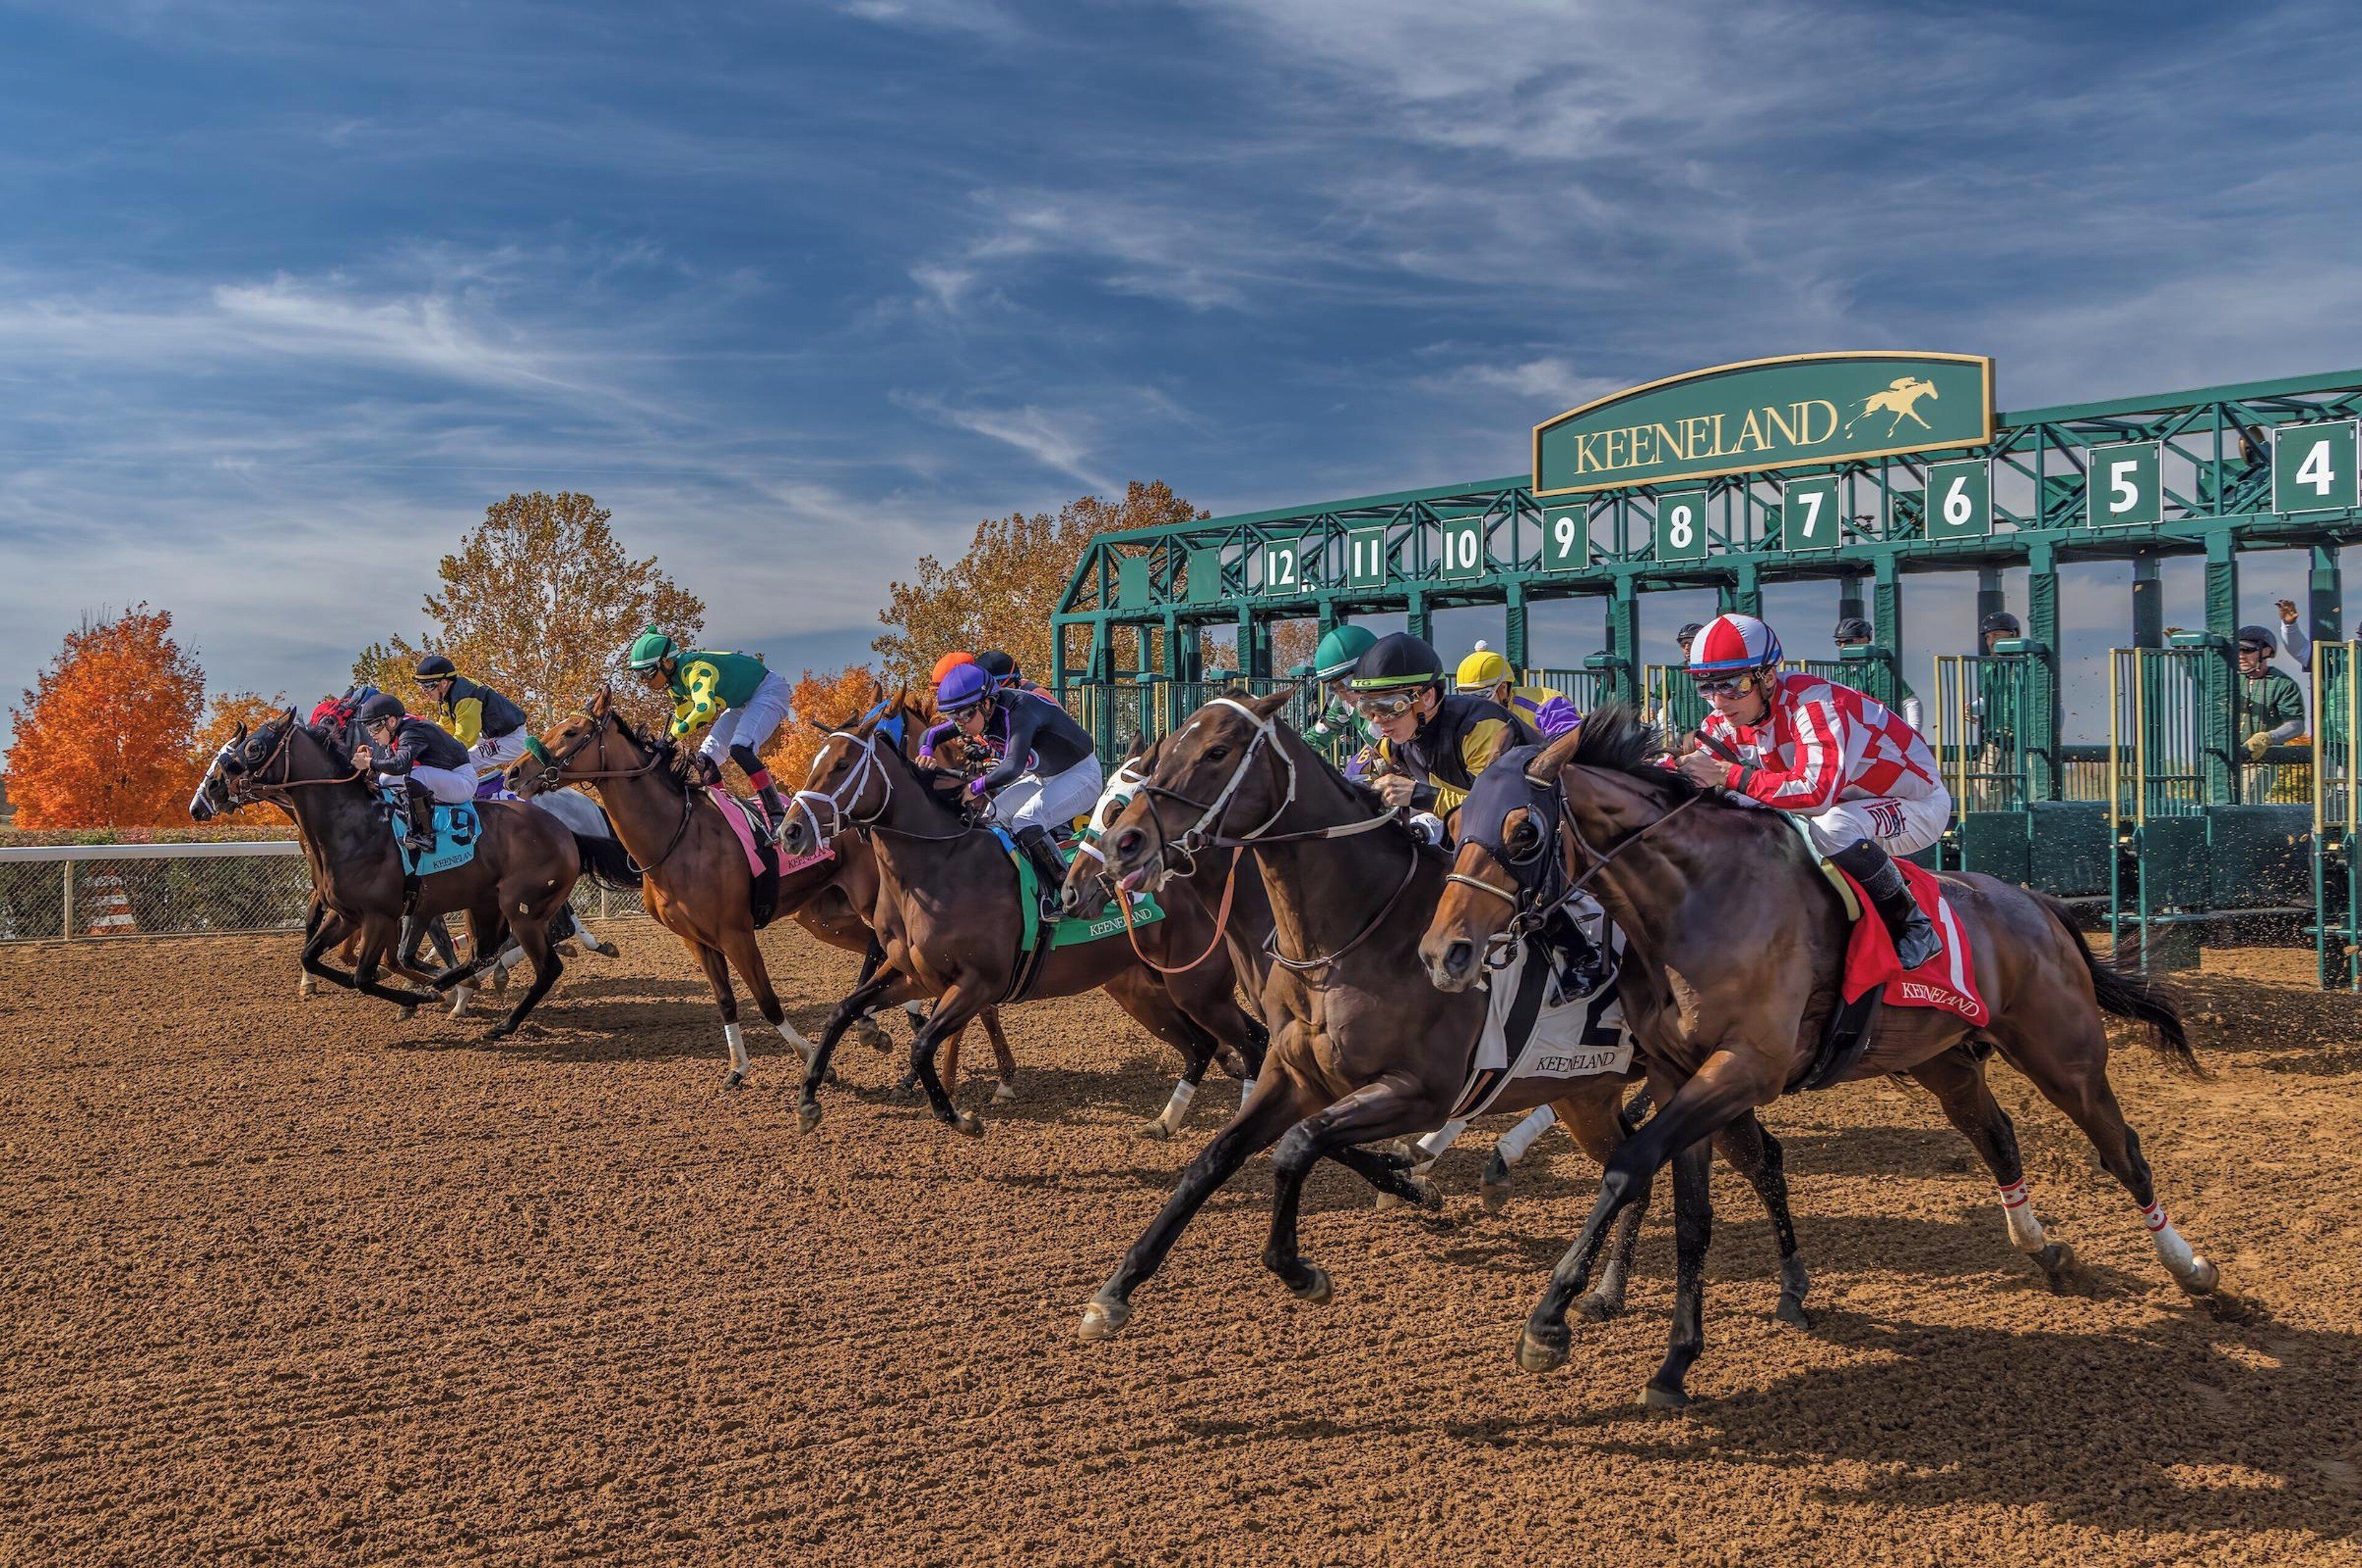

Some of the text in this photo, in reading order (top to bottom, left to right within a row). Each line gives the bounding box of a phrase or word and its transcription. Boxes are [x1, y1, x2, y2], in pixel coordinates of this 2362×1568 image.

[1573, 399, 1839, 474] KEENELAND
[2109, 460, 2138, 513] 5
[2296, 440, 2335, 496] 4
[1799, 491, 1824, 538] 7
[1943, 476, 1972, 525] 6
[1554, 517, 1575, 558] 9
[1669, 505, 1693, 548] 8
[1270, 549, 1295, 586] 12
[1354, 539, 1378, 578] 11
[1446, 530, 1477, 570] 10
[450, 807, 476, 846] 9
[1938, 896, 1975, 1001] 1
